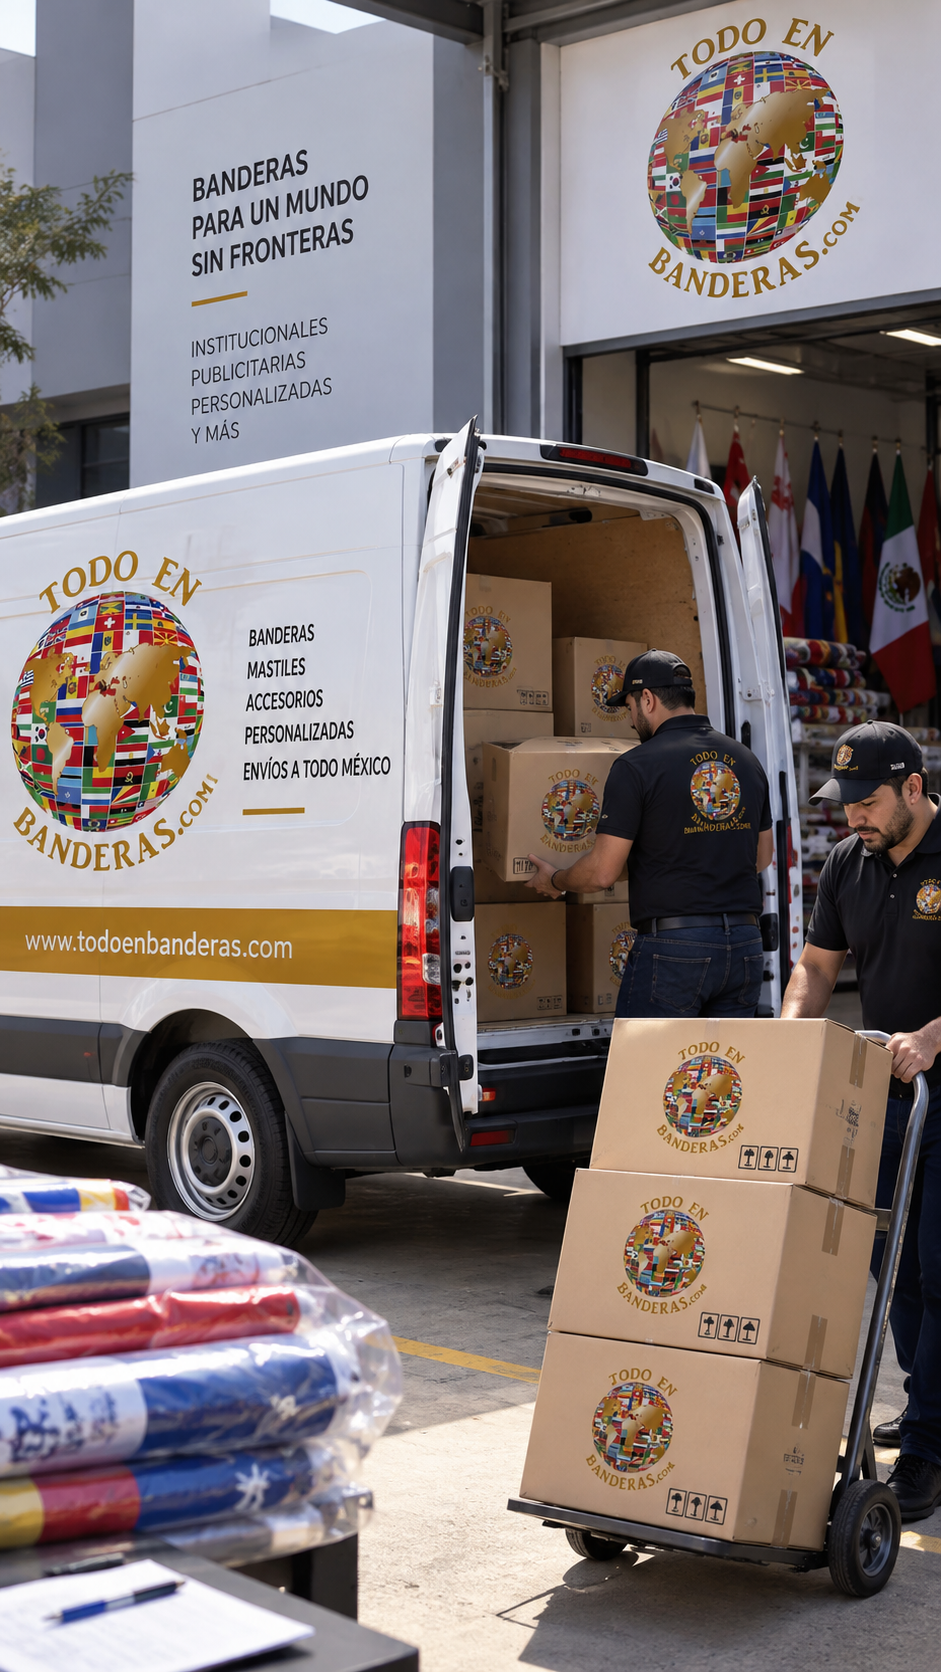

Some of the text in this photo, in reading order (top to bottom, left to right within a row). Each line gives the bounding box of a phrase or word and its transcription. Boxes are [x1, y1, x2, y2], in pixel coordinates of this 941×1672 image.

[670, 18, 834, 80] TODO EN
[192, 149, 309, 202] BANDERAS
[192, 175, 369, 240] PARA UN MUNDO
[191, 218, 354, 277] SIN FRONTERAS
[648, 201, 860, 298] BANDERAS.COM
[191, 317, 328, 358] INSTITUCIONALES
[191, 351, 306, 386] PUBLICITARIAS
[191, 377, 332, 415] PERSONALIZADAS
[191, 419, 240, 444] Y MÁS
[39, 550, 202, 614] TODO EN
[249, 624, 315, 647] BANDERAS
[247, 657, 306, 679] MASTILES
[246, 689, 323, 712] ACCESORIOS
[244, 720, 354, 745] PERSONALIZADAS
[243, 752, 391, 780] ENVÍOS A TODO MÉXICO
[690, 751, 718, 766] TODO
[548, 769, 580, 783] TODO
[25, 929, 293, 959] www.todoenbanderas.com
[678, 1041, 745, 1064] TODO EN
[640, 1196, 709, 1221] TODO EN
[657, 1376, 678, 1397] EN
